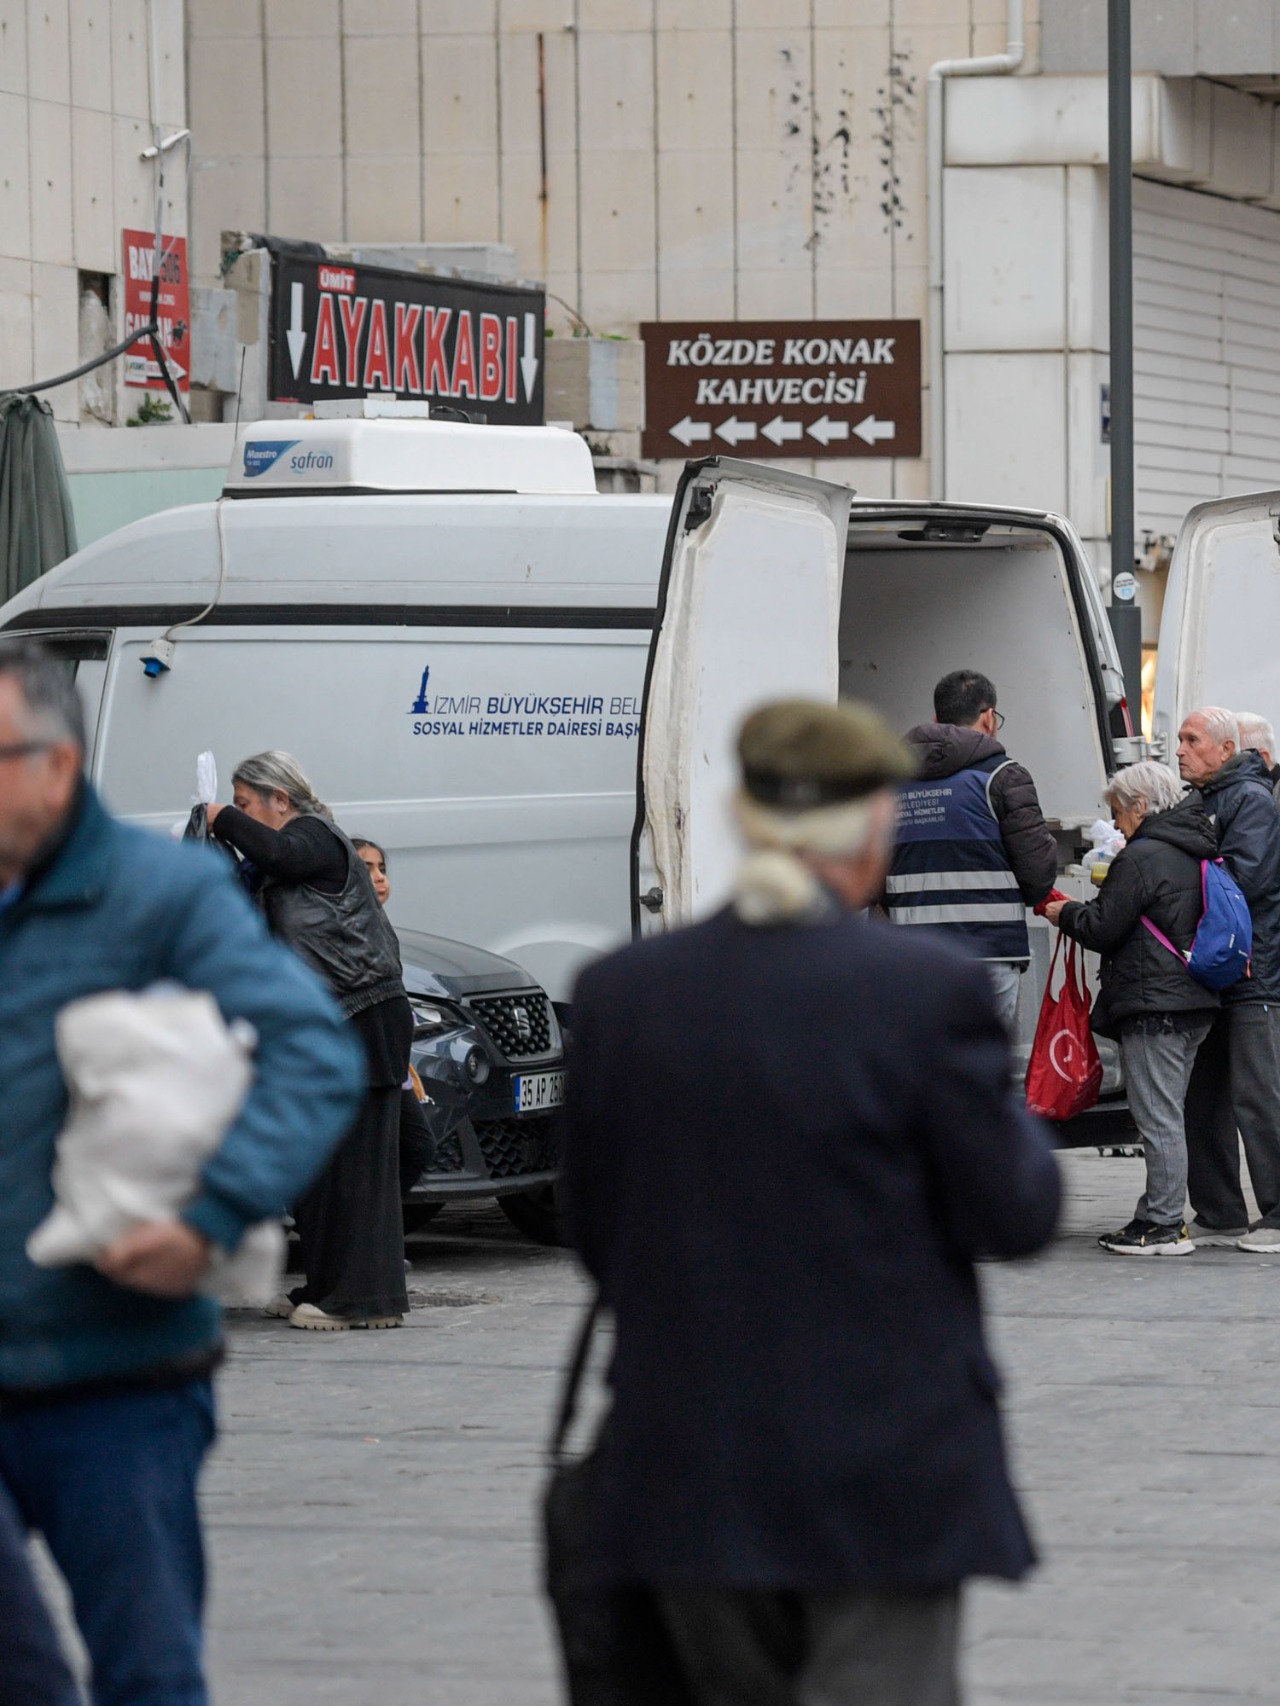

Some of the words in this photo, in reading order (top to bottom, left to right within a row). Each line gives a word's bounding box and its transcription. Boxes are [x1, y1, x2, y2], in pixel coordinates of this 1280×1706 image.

[319, 268, 355, 291] ÜMİT
[310, 292, 518, 403] AYAKKABI
[666, 333, 776, 366] KÖZDE
[781, 338, 896, 365] KONAK
[695, 370, 867, 404] KAHVECİSİ
[290, 450, 334, 470] safran
[433, 694, 482, 715] İZMİR
[486, 692, 604, 717] BÜYÜKŞEHİR
[610, 697, 642, 716] BEL
[413, 721, 465, 736] SOSYAL
[468, 717, 544, 737] HİZMETLER
[547, 717, 603, 737] DAİRESİ
[522, 1079, 533, 1107] 35
[536, 1077, 546, 1106] AP
